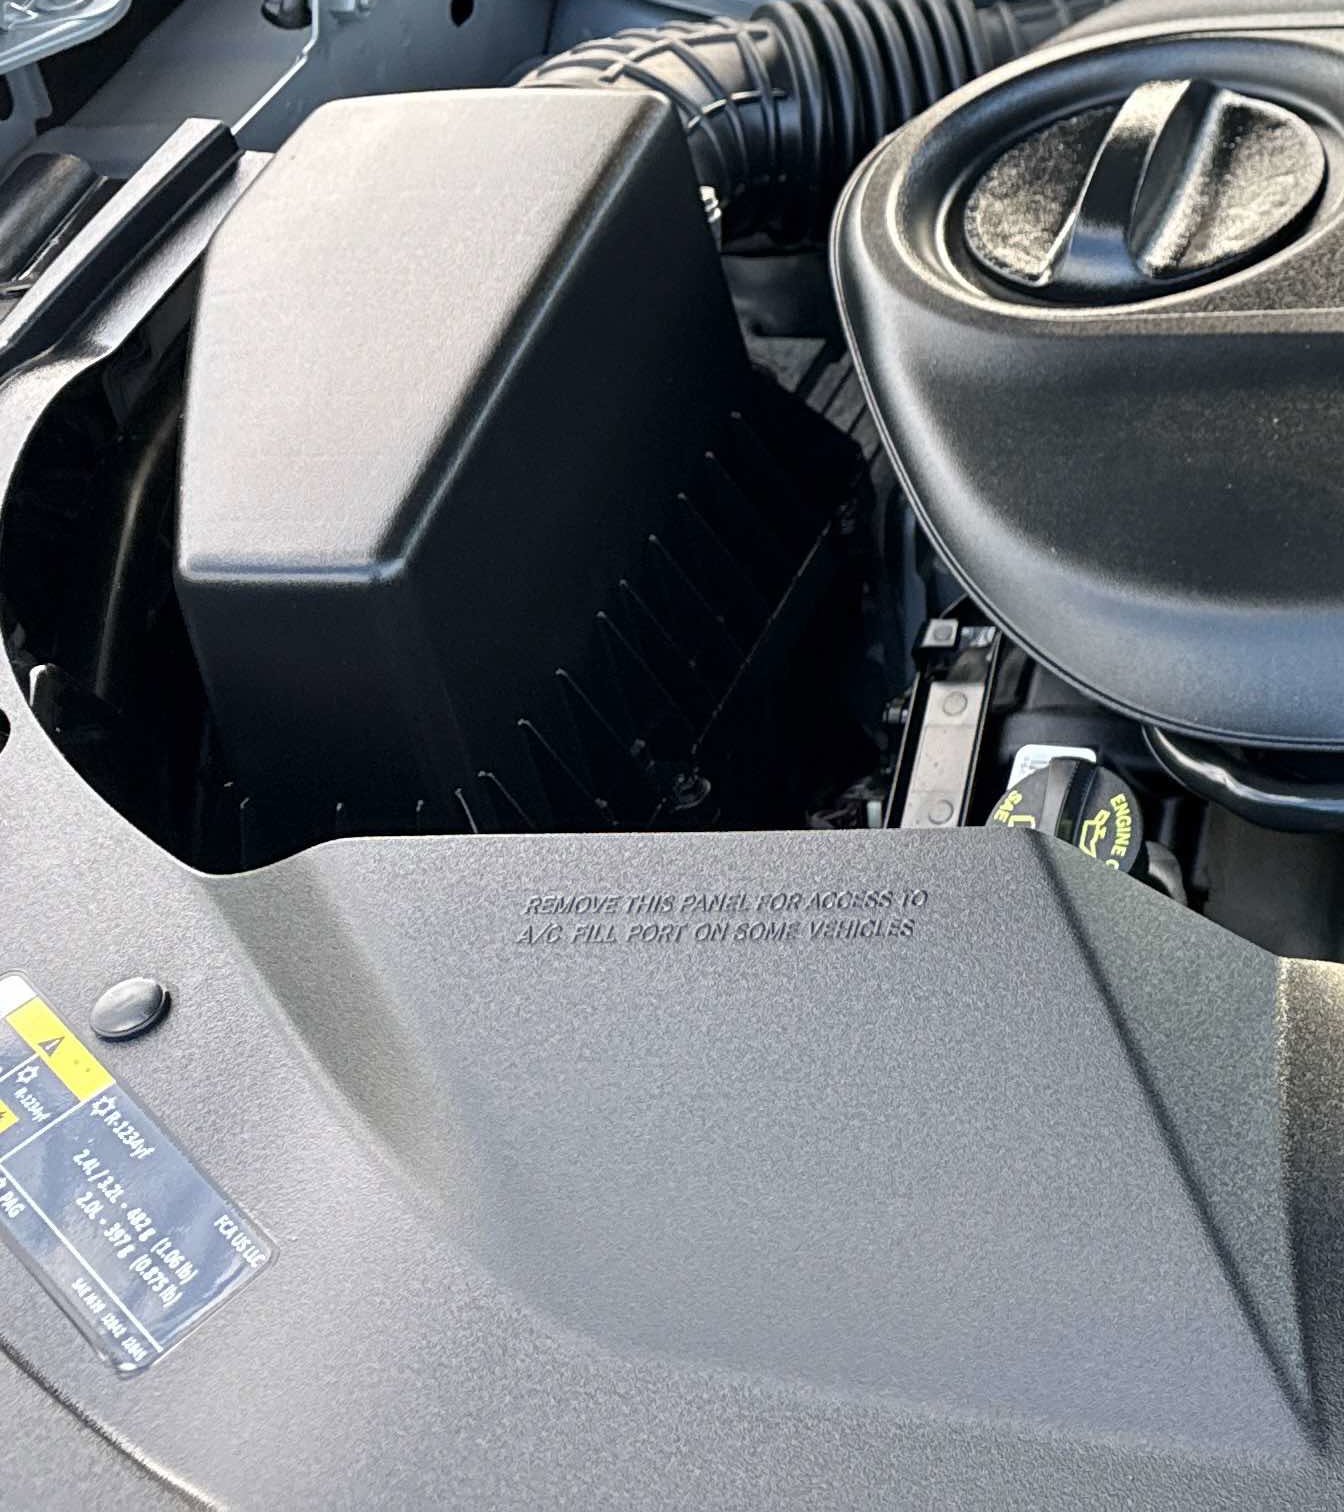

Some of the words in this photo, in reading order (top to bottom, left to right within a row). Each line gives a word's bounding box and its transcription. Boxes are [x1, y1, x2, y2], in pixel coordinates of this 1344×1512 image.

[993, 790, 1023, 823] SAE
[1110, 793, 1133, 857] ENGINE
[522, 894, 624, 915] REMOVE
[626, 894, 676, 914] THIS
[680, 892, 750, 914] PANEL
[755, 892, 802, 912] FOR
[806, 890, 893, 910] ACCESS
[900, 889, 928, 909] TO
[516, 923, 563, 944] A/C
[571, 923, 618, 944] FILL
[626, 922, 688, 944] PORT
[694, 921, 730, 942] ON
[733, 921, 800, 941] SOME
[808, 918, 916, 939] VEHICLES
[104, 1111, 155, 1159] R-1234yf
[0, 1191, 25, 1217] PAG
[214, 1215, 238, 1239] FCA
[232, 1233, 251, 1252] US
